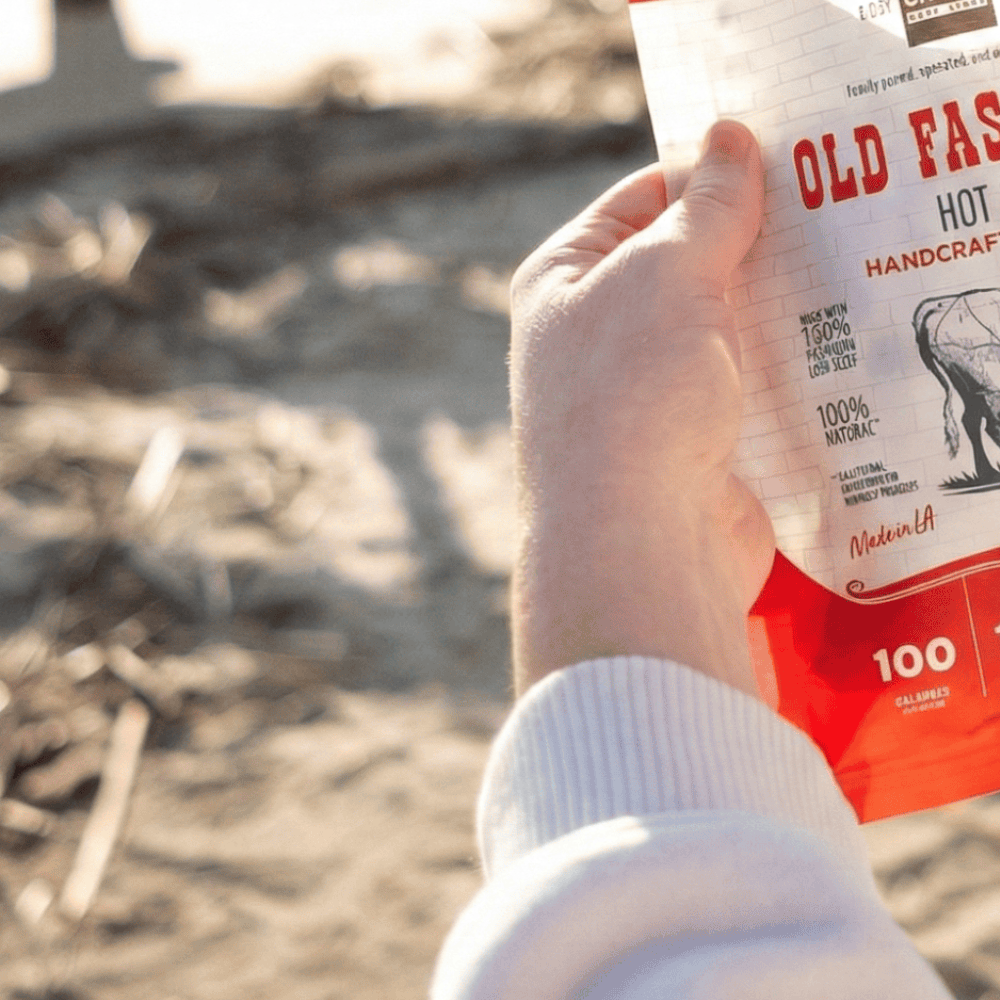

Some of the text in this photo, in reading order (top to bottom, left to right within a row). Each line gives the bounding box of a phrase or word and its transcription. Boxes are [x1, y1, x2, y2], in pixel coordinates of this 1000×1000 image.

[792, 123, 889, 211] OLD
[936, 184, 990, 232] HOT
[816, 394, 870, 429] 100%
[872, 636, 957, 683] 100
